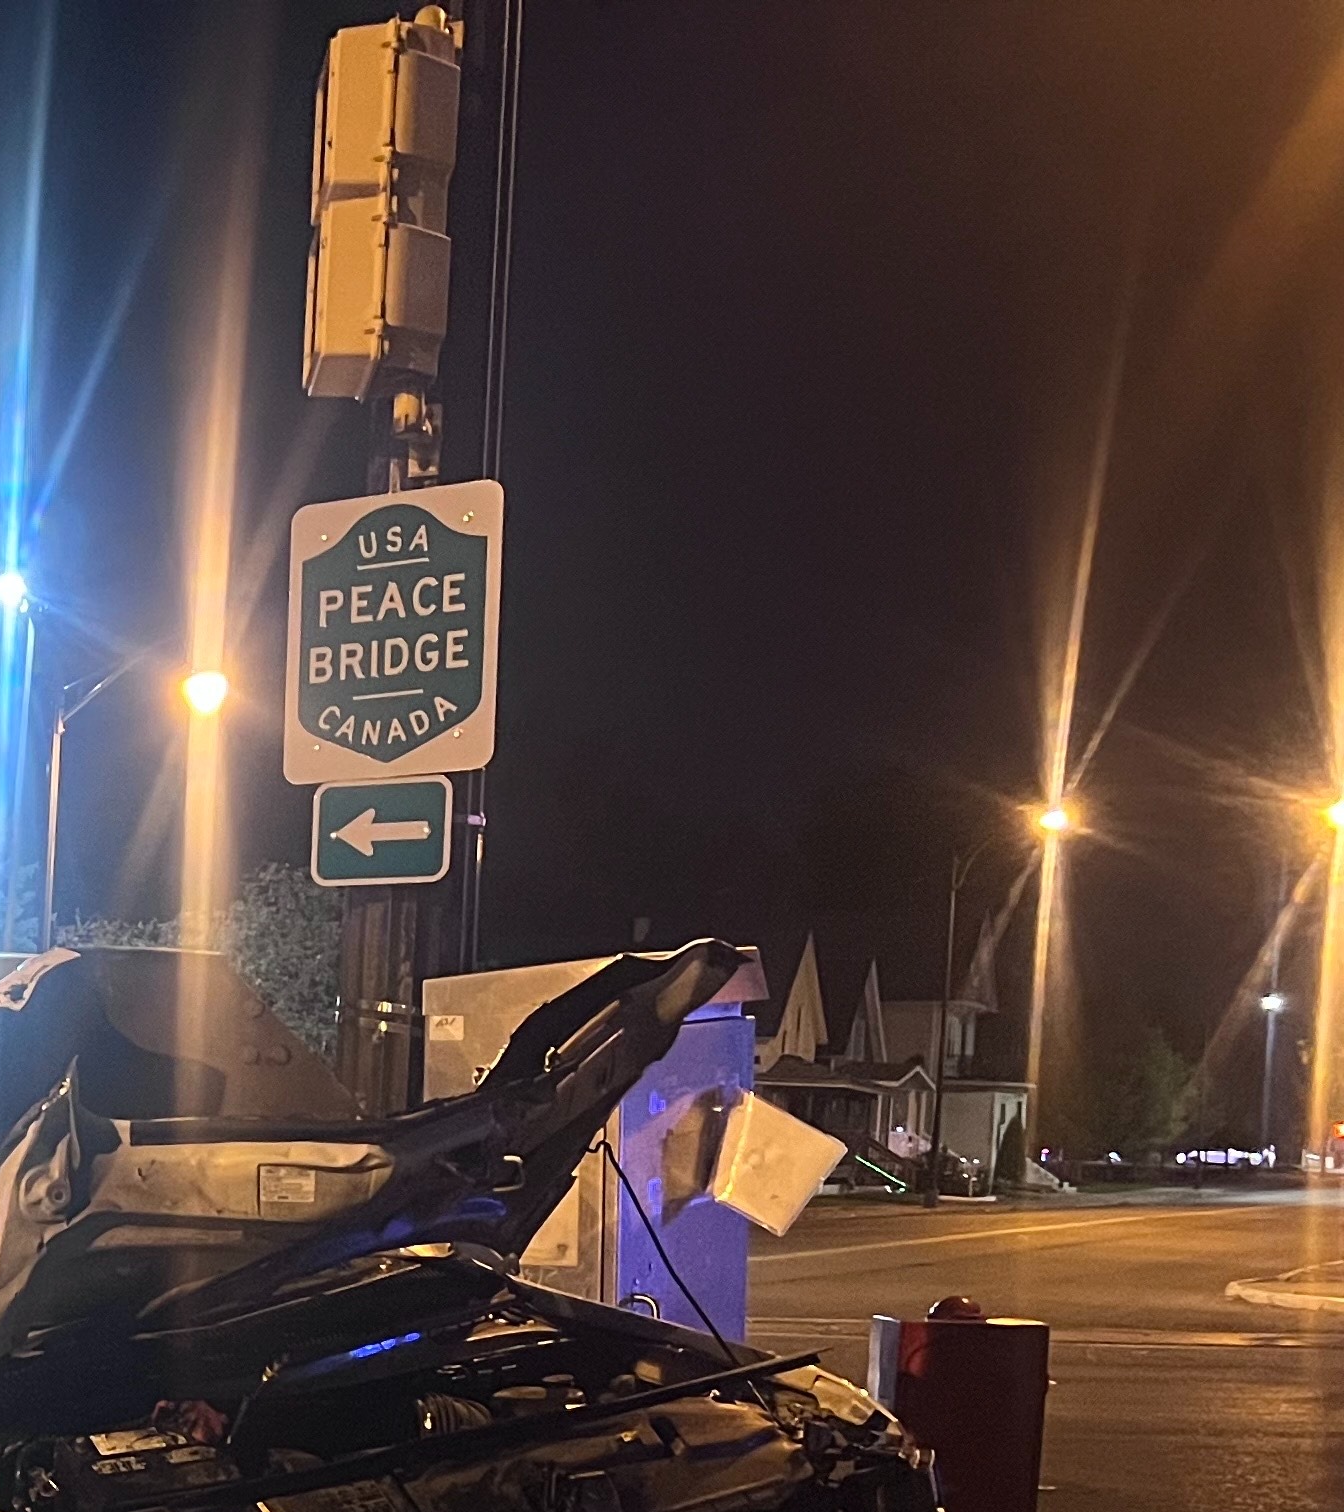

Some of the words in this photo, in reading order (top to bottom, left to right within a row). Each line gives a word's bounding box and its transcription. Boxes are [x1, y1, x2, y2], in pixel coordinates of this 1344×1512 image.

[358, 525, 430, 559] USA
[318, 573, 467, 628] PEACE
[309, 629, 470, 685] BRIDGE
[317, 695, 458, 746] CANADA
